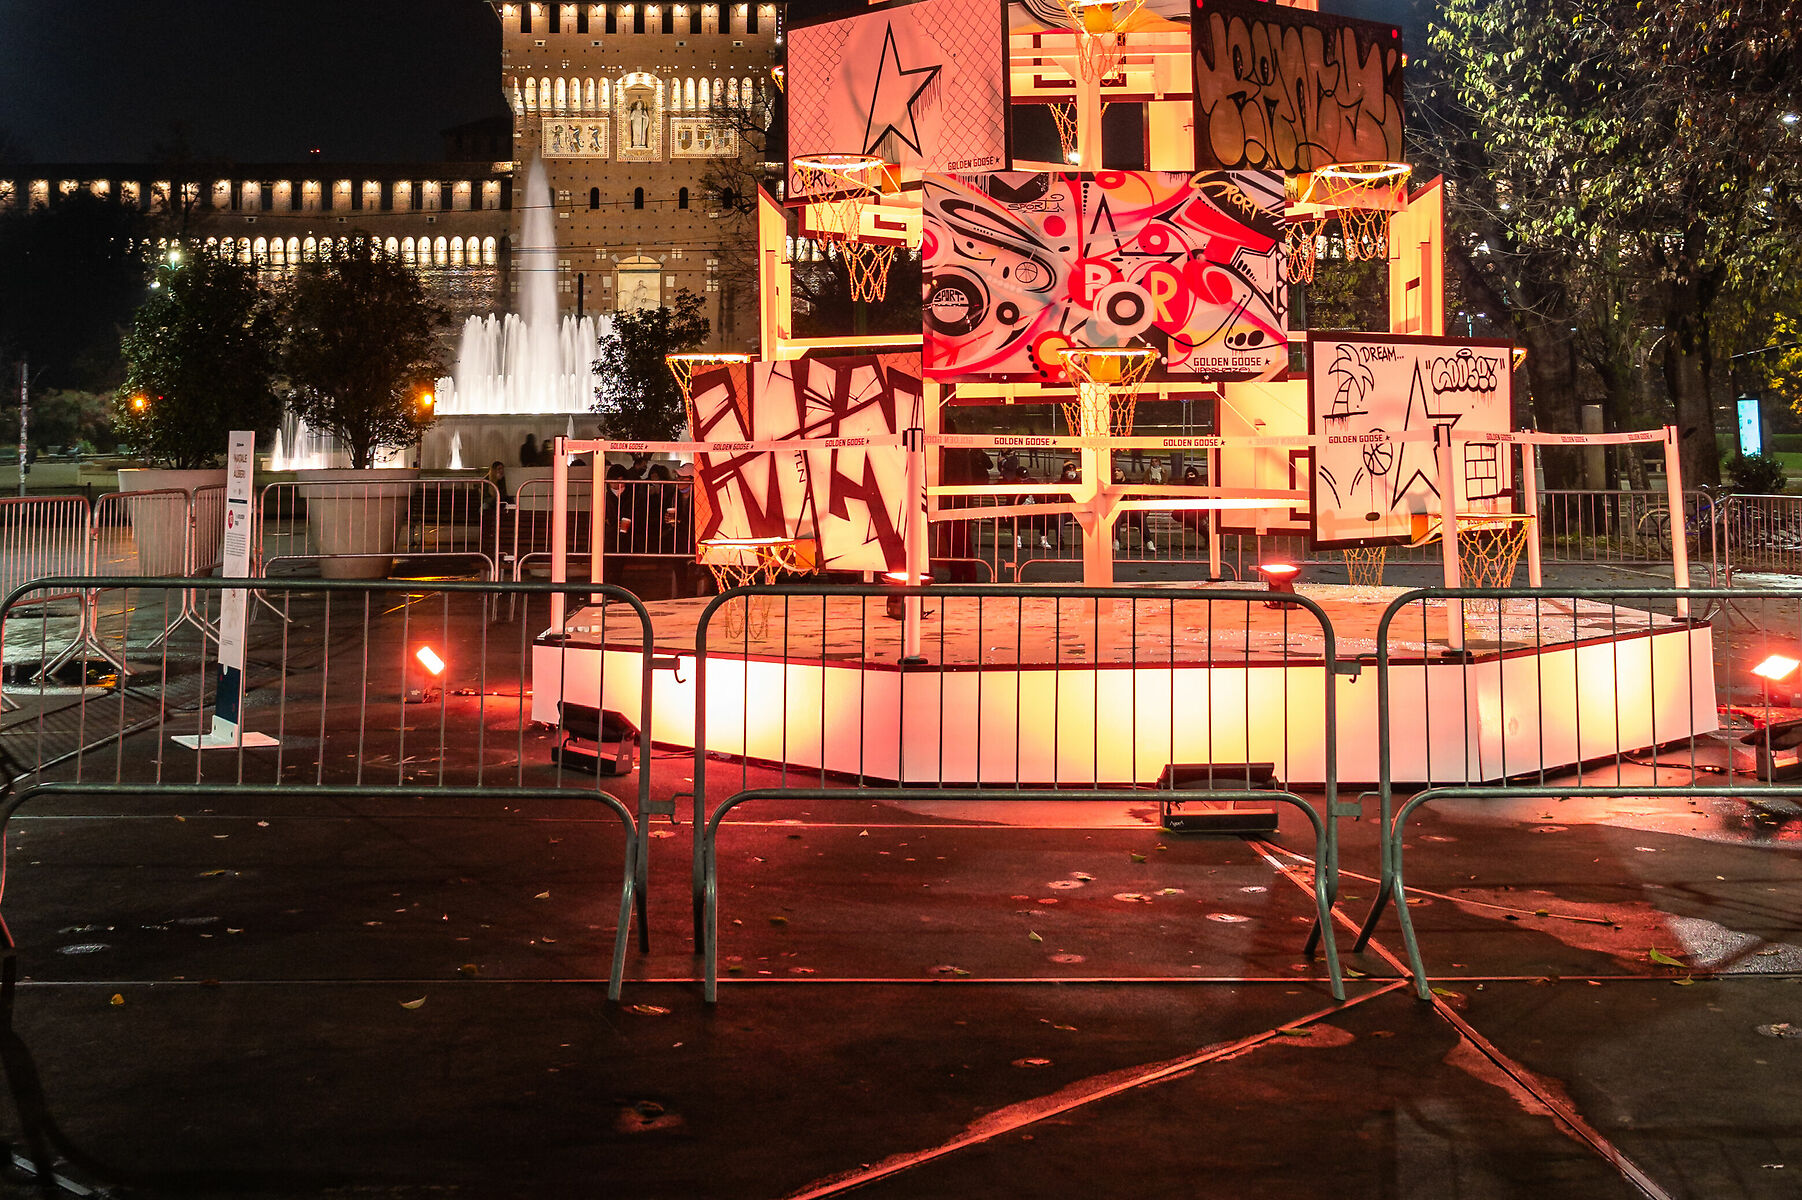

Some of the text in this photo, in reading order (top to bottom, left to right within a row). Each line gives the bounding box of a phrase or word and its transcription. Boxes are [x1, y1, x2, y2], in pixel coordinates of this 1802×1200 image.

[948, 156, 995, 171] GOLDEN GOOSE
[1193, 358, 1262, 367] GOLDEN GOOSE
[825, 438, 865, 447] GOLDEN GOOSE
[994, 437, 1050, 446] GOLDEN GOOSE
[1163, 438, 1218, 447] GOLDEN GOOSE
[1328, 434, 1383, 444] GOLDEN GOOSE
